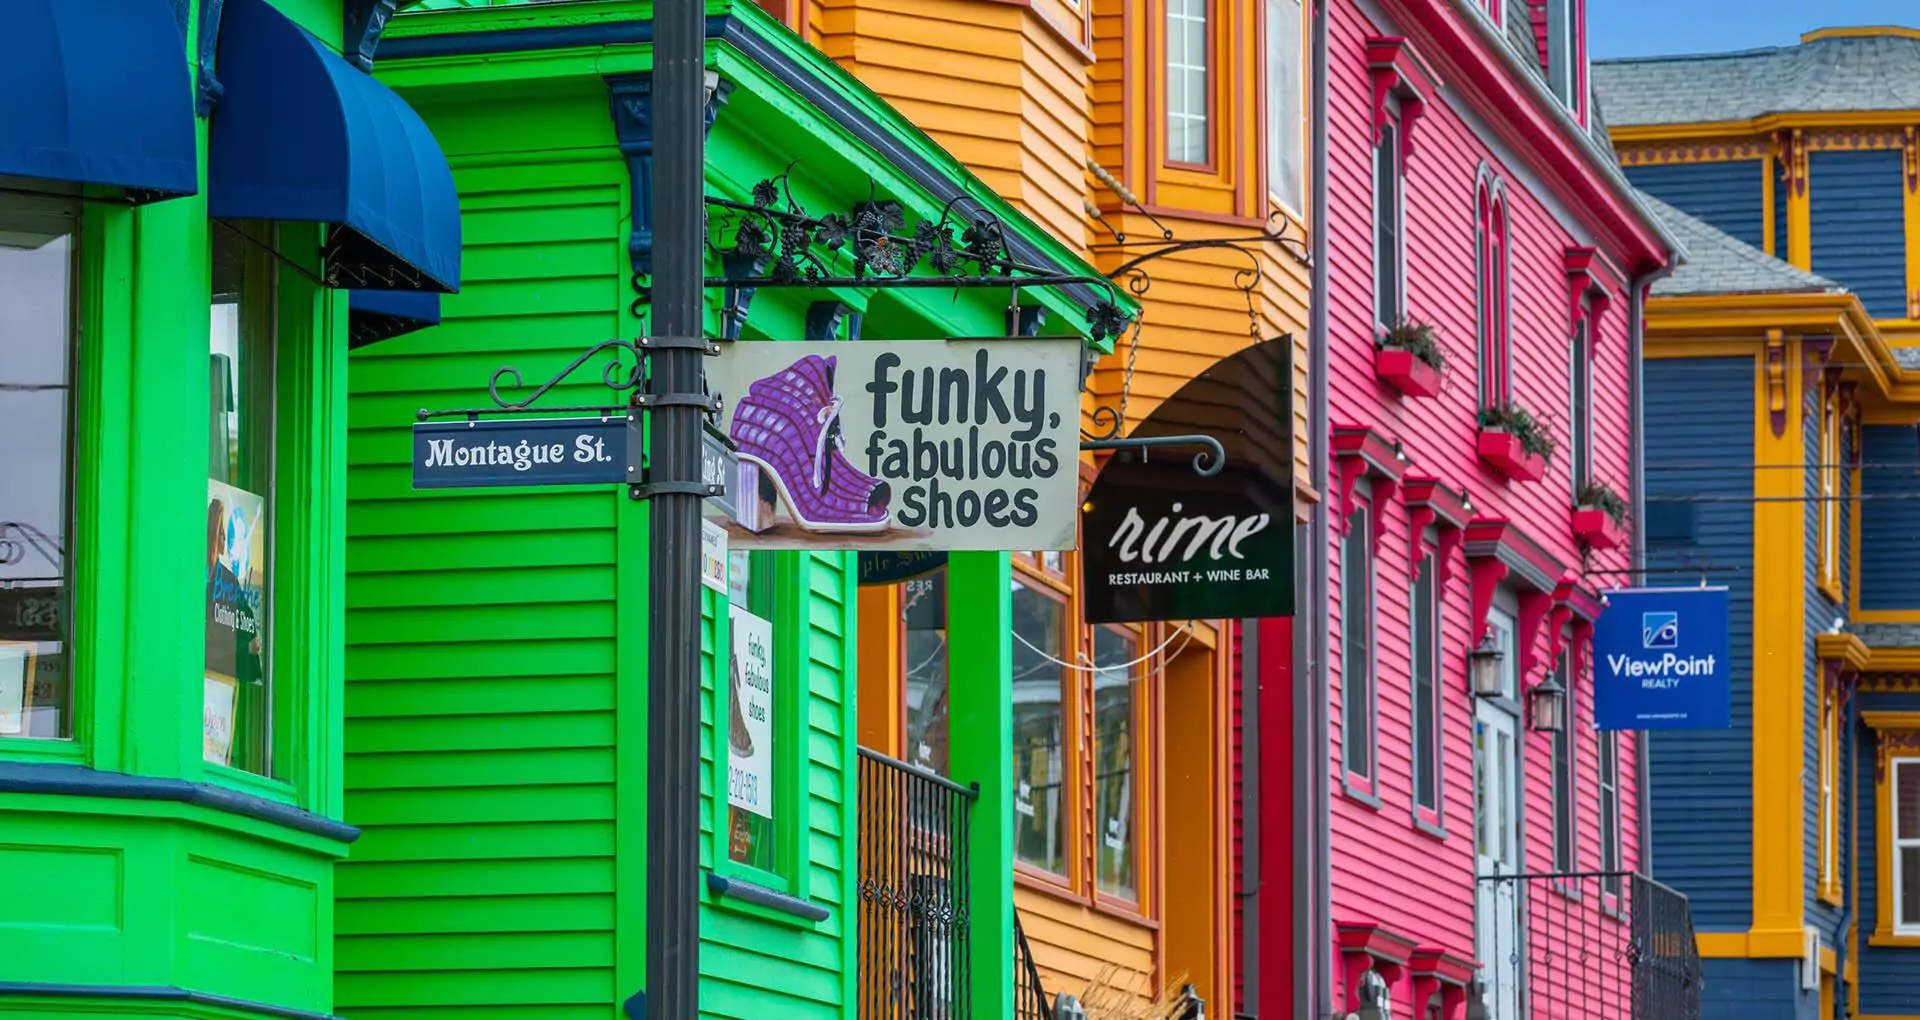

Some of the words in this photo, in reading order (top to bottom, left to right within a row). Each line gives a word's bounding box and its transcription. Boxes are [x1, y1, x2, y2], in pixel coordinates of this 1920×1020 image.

[865, 348, 1061, 441] funky,
[424, 438, 564, 471] Montague
[573, 434, 612, 463] St.
[702, 444, 716, 486] ing
[865, 425, 1059, 482] fabulous
[1108, 502, 1270, 563] rime
[1108, 571, 1190, 585] RESTAURANT
[1192, 573, 1203, 583] +
[1206, 569, 1241, 582] WINE
[1246, 568, 1270, 580] BAR
[240, 610, 255, 634] Shoes
[745, 662, 770, 694] fabulous
[1607, 653, 1716, 677] ViewPoint
[1641, 679, 1680, 689] REALTY
[748, 695, 766, 723] shoes
